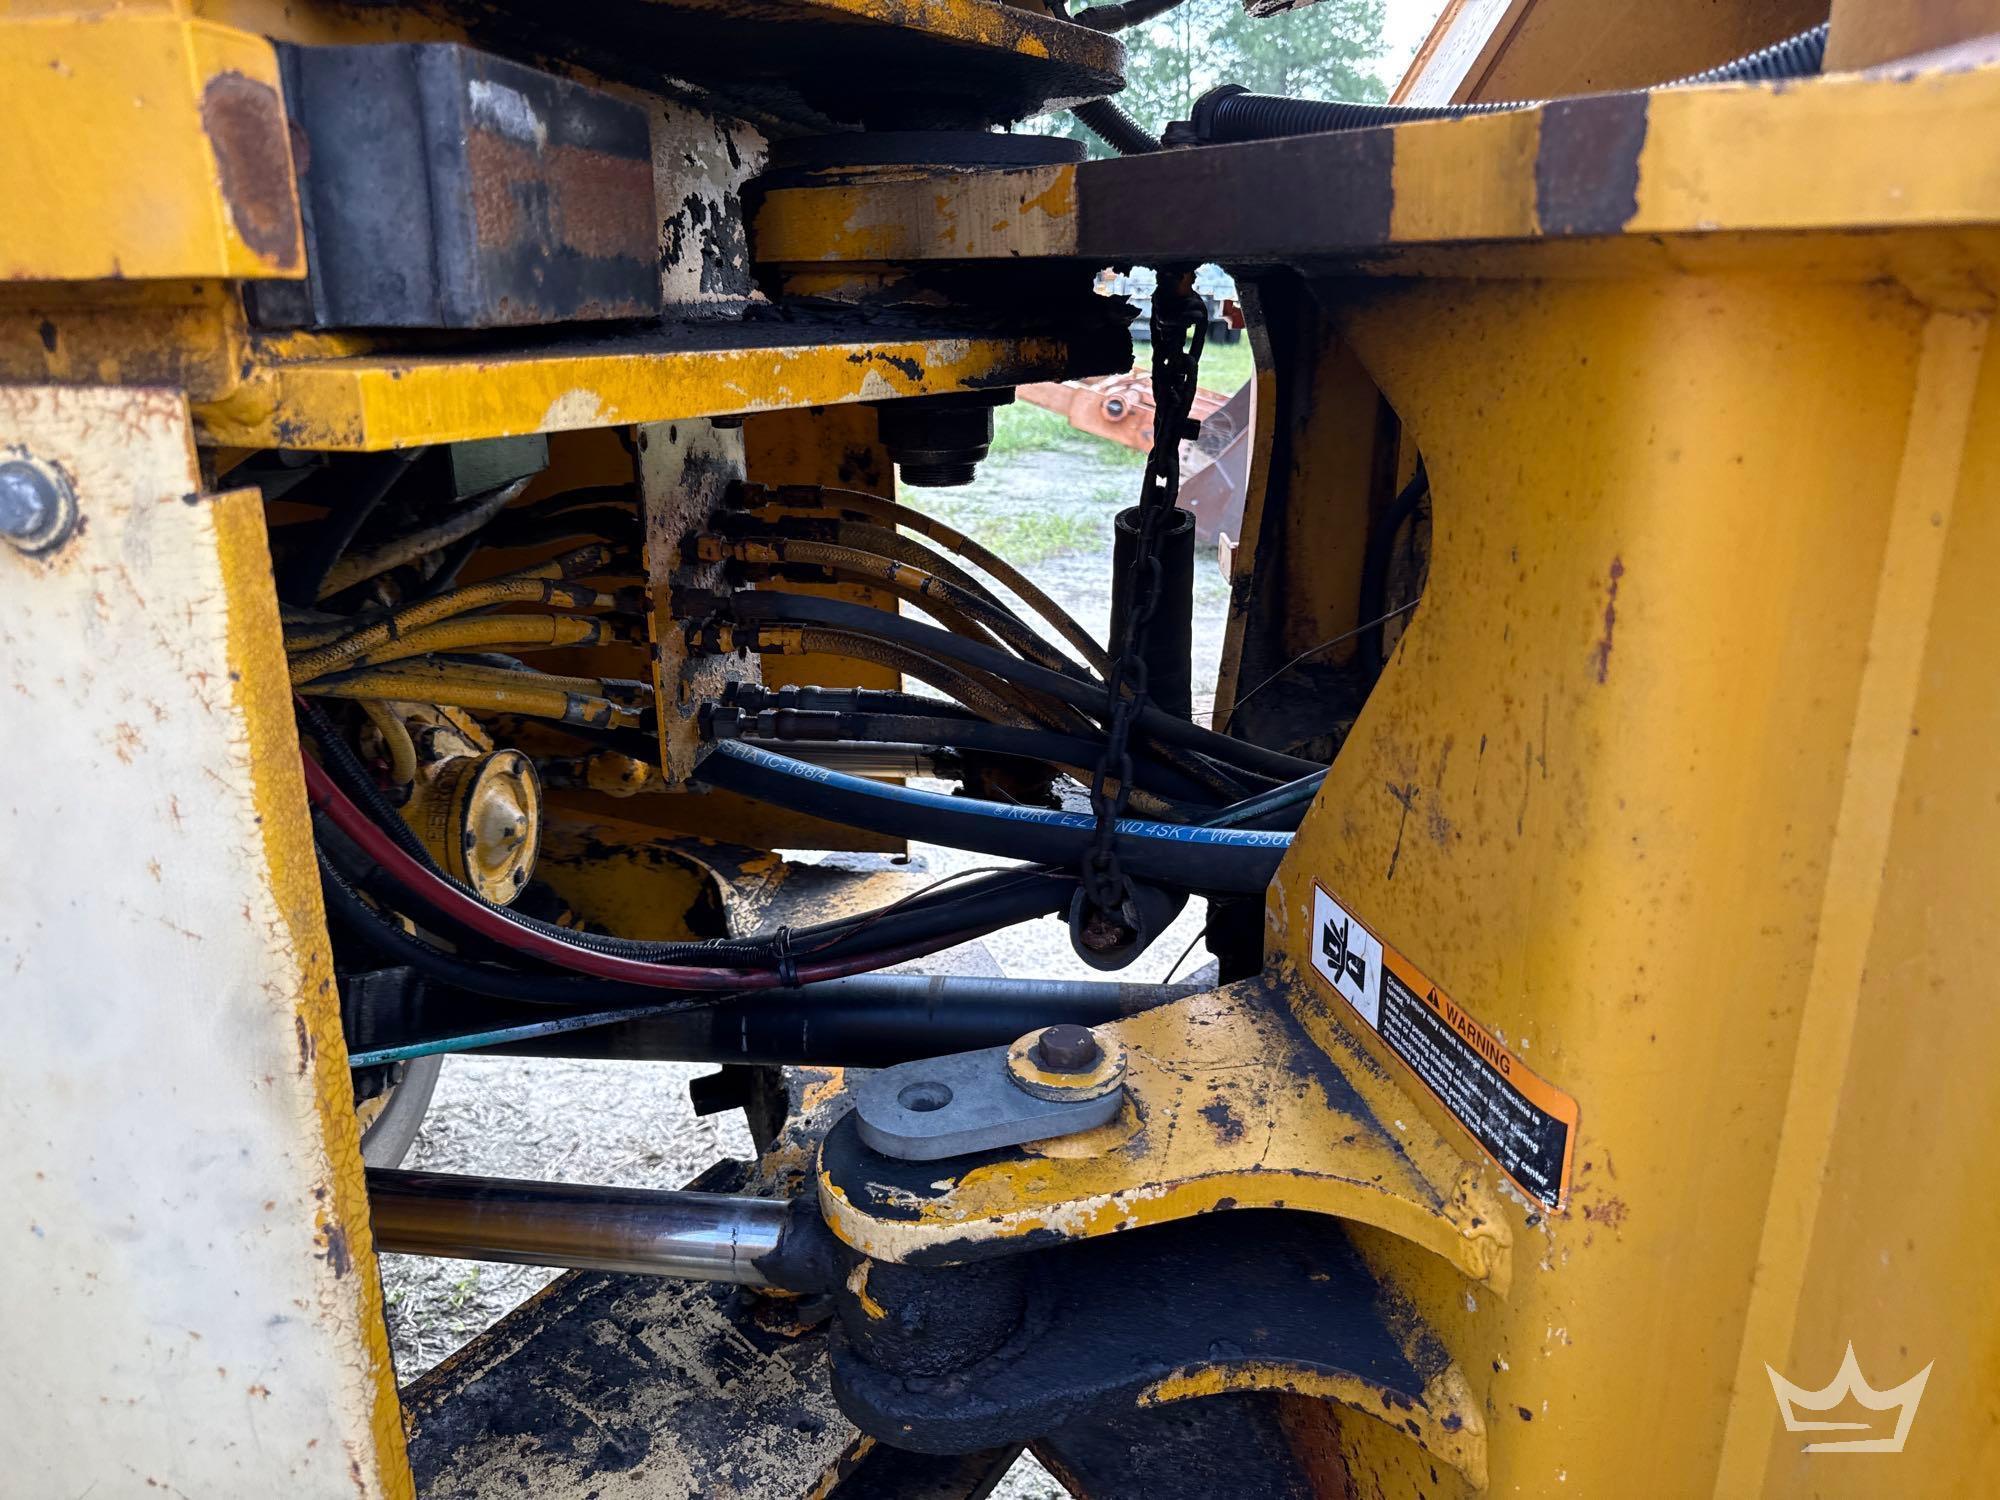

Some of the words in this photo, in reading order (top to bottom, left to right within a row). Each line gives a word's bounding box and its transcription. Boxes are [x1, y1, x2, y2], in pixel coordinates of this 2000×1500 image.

[722, 741, 758, 761] SHA
[1385, 1010, 1402, 1029] engine
[1409, 1033, 1429, 1058] moving
[1387, 976, 1411, 1005] Crushing
[1427, 1014, 1440, 1032] may
[1440, 1027, 1456, 1047] result
[1457, 1042, 1463, 1053] in
[1464, 1050, 1481, 1070] hinge
[1482, 1068, 1495, 1084] area
[1446, 1002, 1510, 1075] WARNING
[1386, 997, 1399, 1015] Make
[1400, 1013, 1412, 1028] sure
[1412, 1026, 1431, 1047] people
[1431, 1043, 1440, 1056] are
[1441, 1054, 1455, 1071] clear
[1489, 1101, 1510, 1126] before
[1510, 1125, 1539, 1153] starting
[1401, 1037, 1420, 1061] locking
[1421, 1056, 1430, 1070] bar
[1431, 1067, 1449, 1090] before
[1449, 1088, 1481, 1125] performing
[1482, 1121, 1504, 1148] service
[1505, 1145, 1520, 1163] near
[1521, 1161, 1549, 1186] center
[1418, 1064, 1452, 1106] transporting
[1452, 1100, 1460, 1113] on
